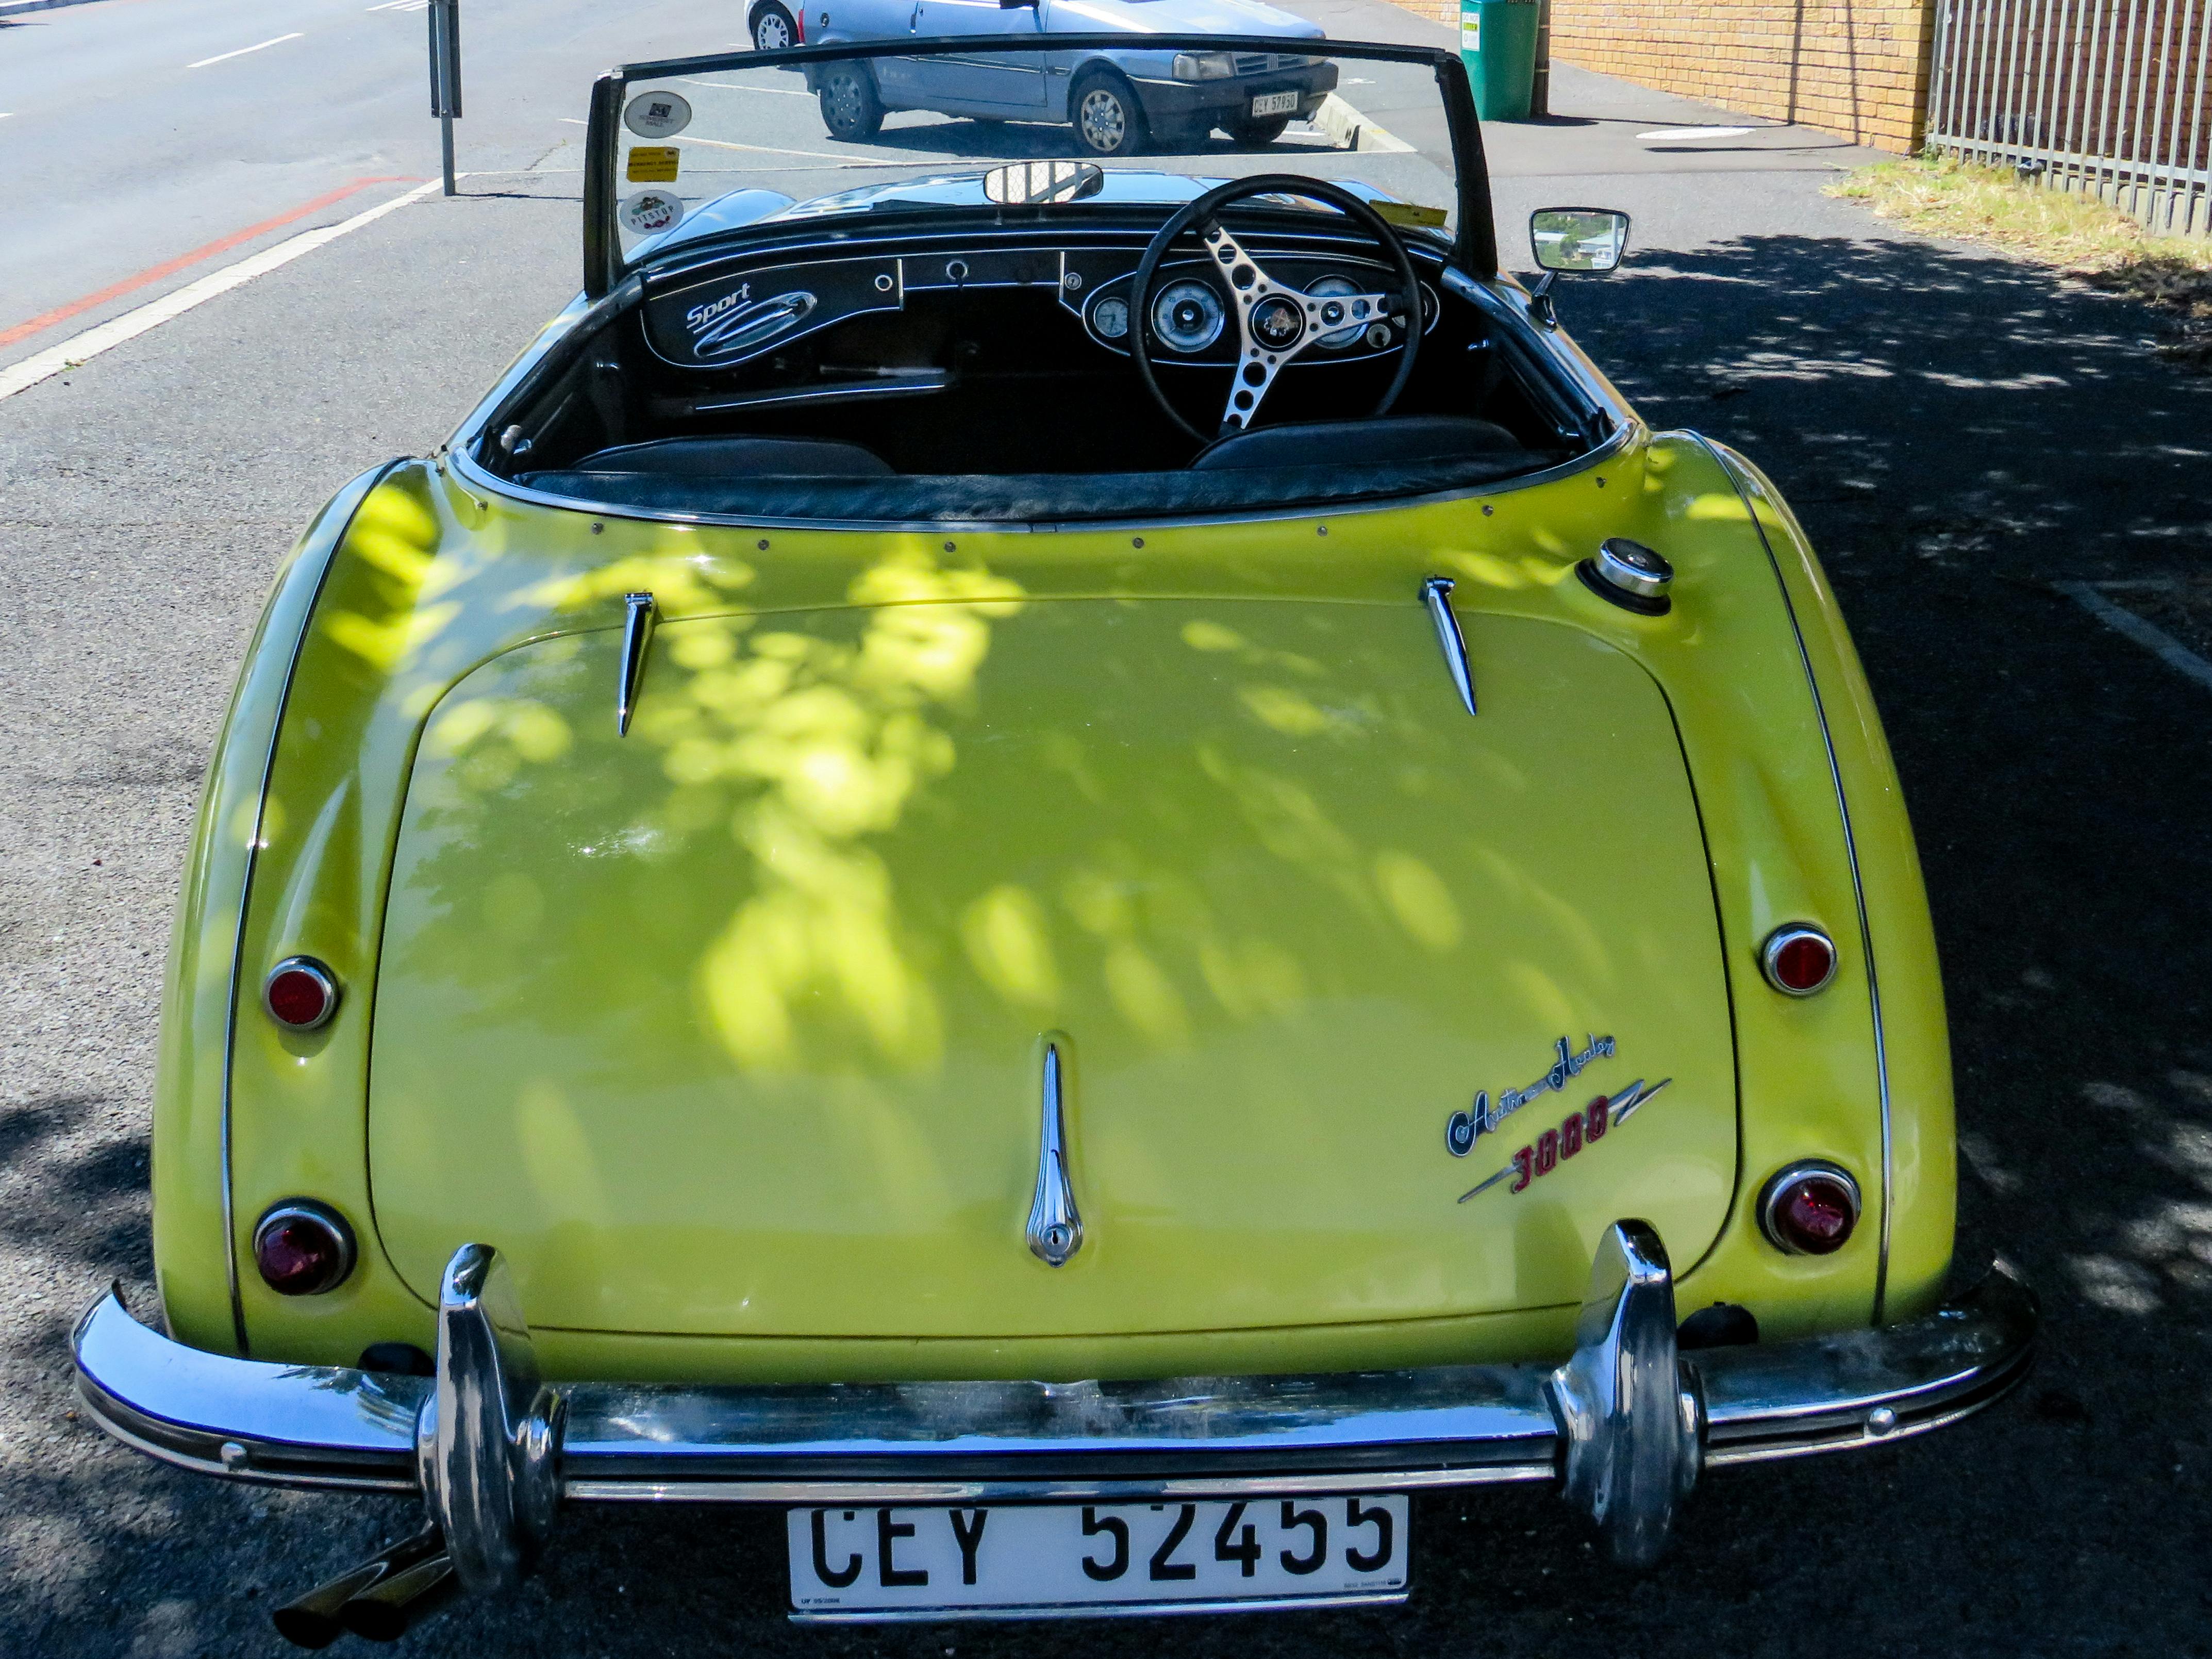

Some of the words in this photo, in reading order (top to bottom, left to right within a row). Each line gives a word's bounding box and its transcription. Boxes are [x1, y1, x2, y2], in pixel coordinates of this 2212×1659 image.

[631, 205, 674, 226] PITSTOP
[686, 283, 750, 329] Sport
[1511, 1096, 1608, 1193] 3000
[811, 1508, 988, 1587] CEY
[1083, 1498, 1393, 1581] 52455
